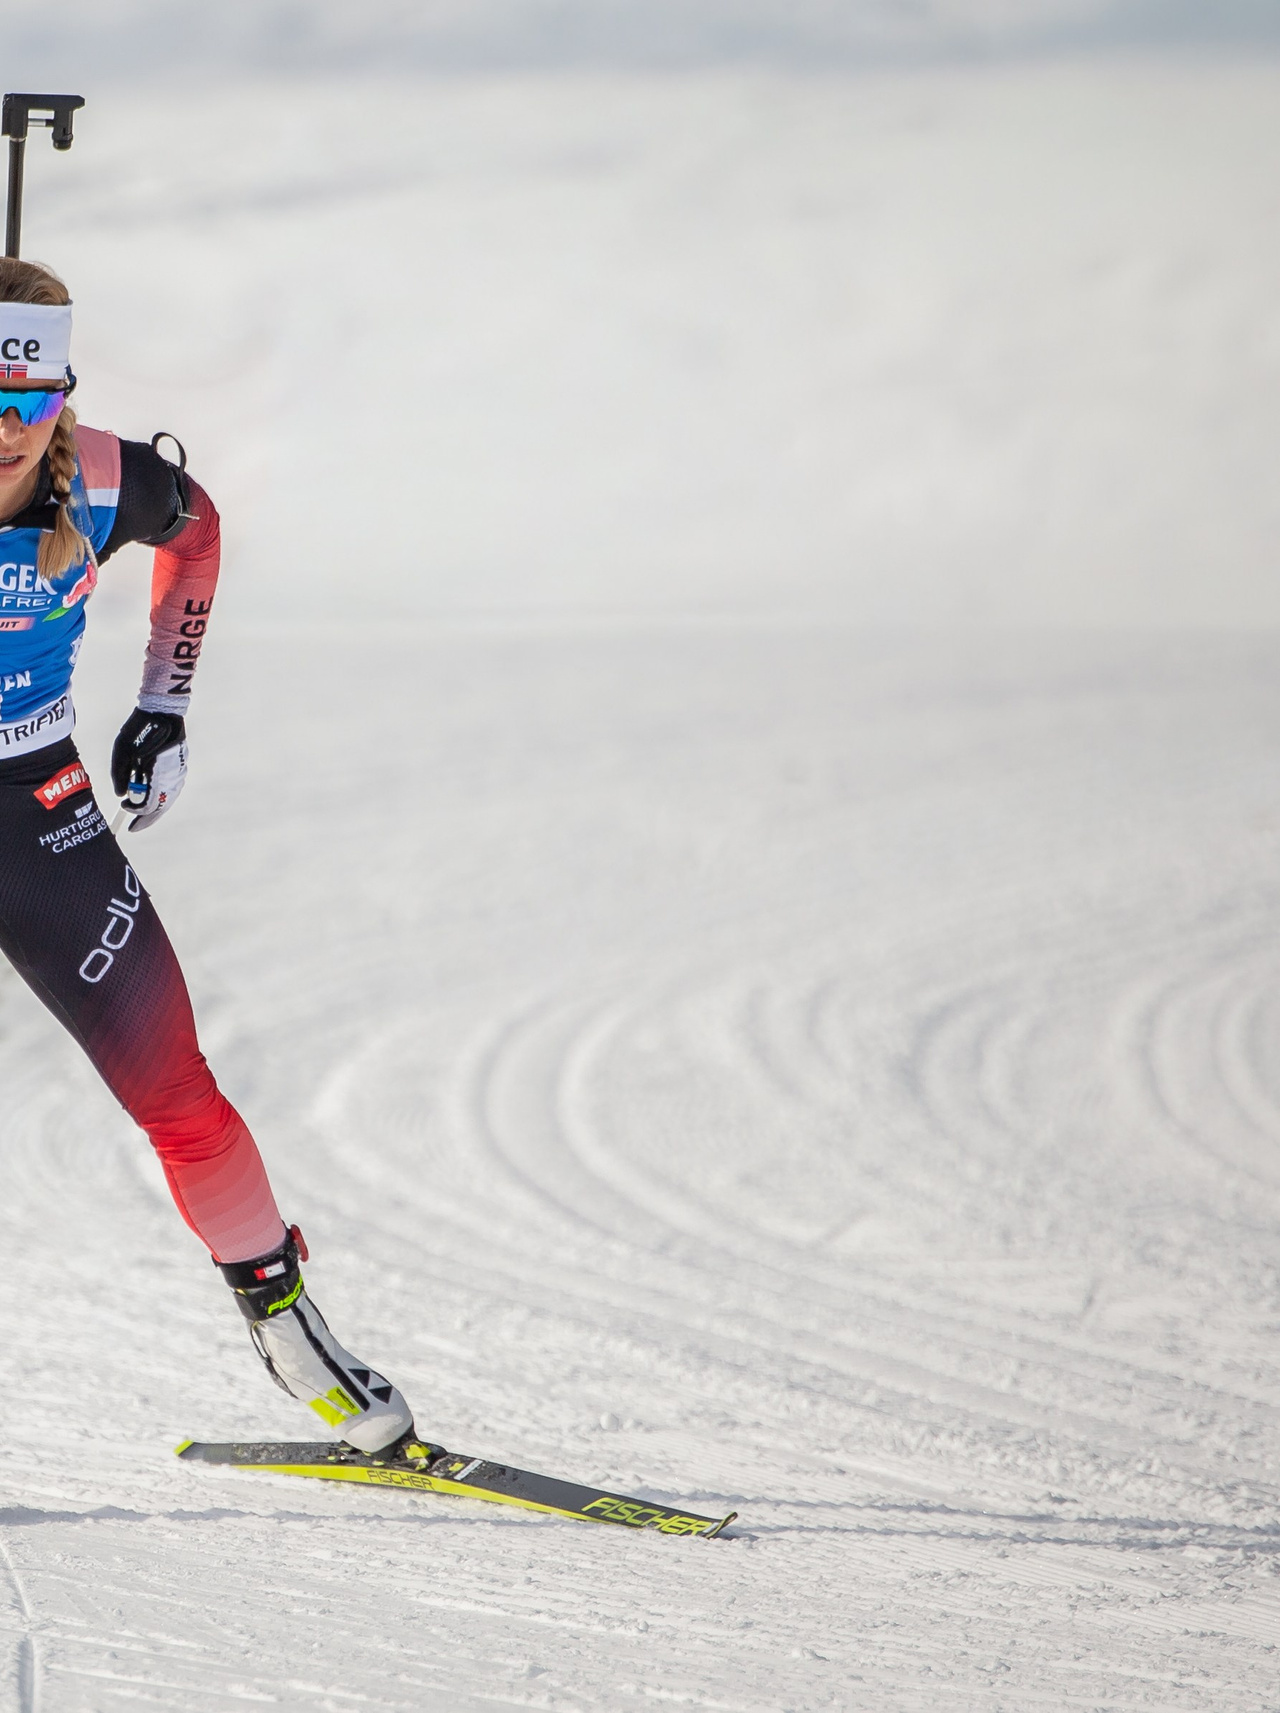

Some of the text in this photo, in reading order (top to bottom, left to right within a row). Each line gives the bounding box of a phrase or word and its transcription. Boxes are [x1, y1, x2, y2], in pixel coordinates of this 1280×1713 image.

[79, 865, 141, 983] odlo
[366, 1469, 435, 1491] FISCHER
[581, 1497, 712, 1536] FISCHER
